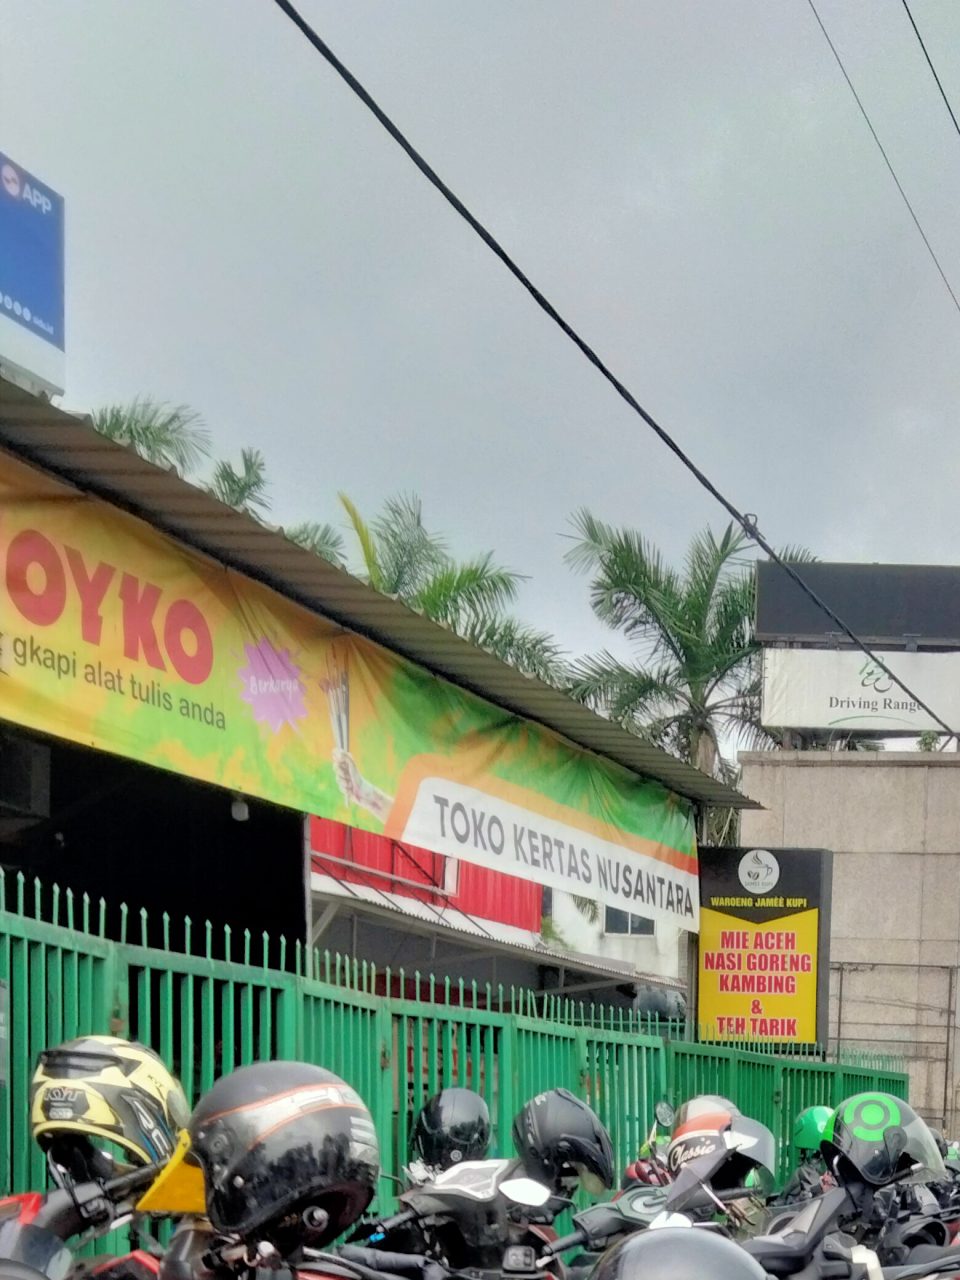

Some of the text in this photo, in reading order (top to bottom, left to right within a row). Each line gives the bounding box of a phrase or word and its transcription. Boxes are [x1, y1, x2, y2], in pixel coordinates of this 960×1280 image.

[84, 661, 125, 695] alat
[131, 674, 173, 711] tulis
[179, 698, 226, 730] anda
[829, 696, 878, 710] Driving
[433, 794, 694, 918] TOKO KERTAS NUSANTARA
[710, 896, 753, 908] WAROENG
[786, 898, 807, 908] KUPI
[720, 931, 795, 950] MIE ACEH
[704, 952, 811, 972] NASI GORENG
[719, 974, 795, 994] KAMBING
[751, 999, 763, 1014] &
[717, 1017, 797, 1036] TEH TARIK
[671, 1137, 716, 1171] Classic
